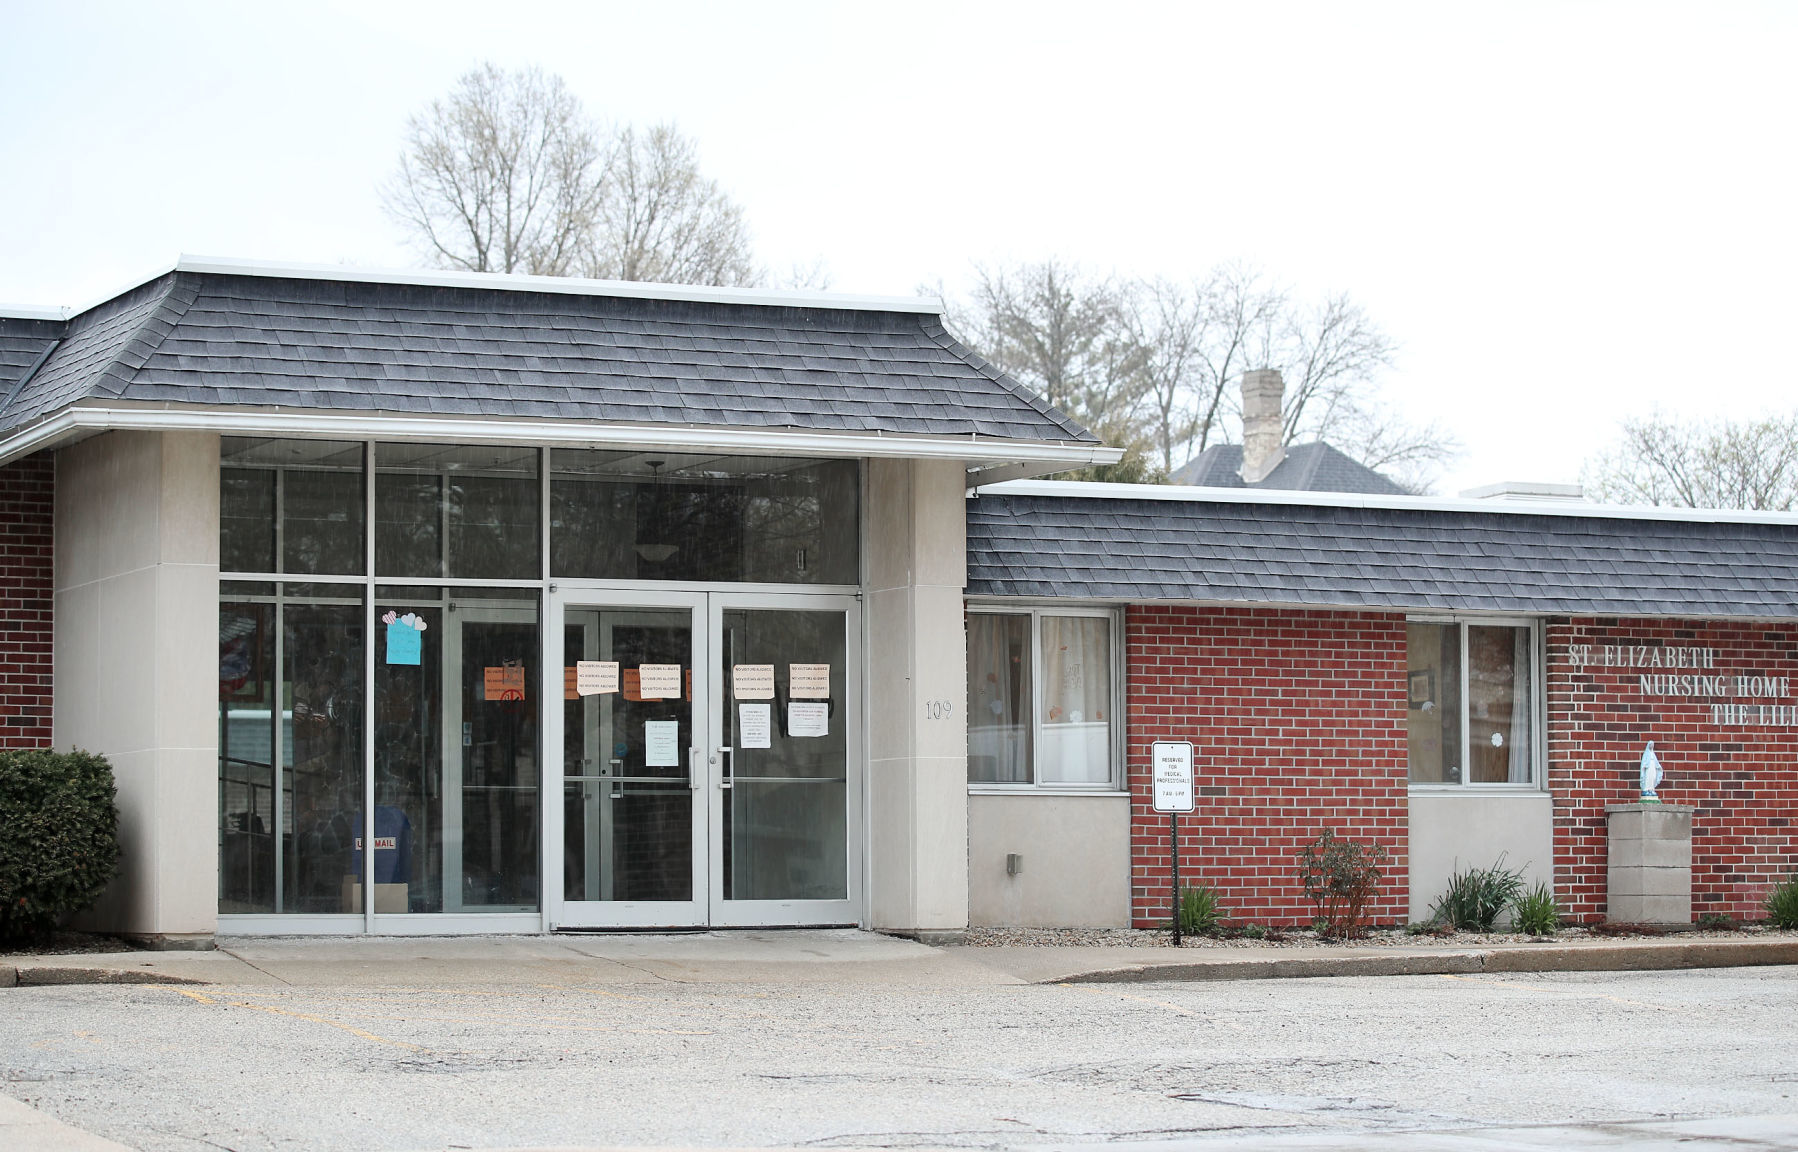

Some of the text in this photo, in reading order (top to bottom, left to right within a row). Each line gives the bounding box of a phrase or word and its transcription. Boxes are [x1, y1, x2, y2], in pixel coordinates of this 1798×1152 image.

[1568, 643, 1714, 669] ST. ELIZABETH
[1639, 674, 1791, 698] NURSING HOME
[926, 699, 954, 720] 109
[1711, 703, 1749, 726] THE
